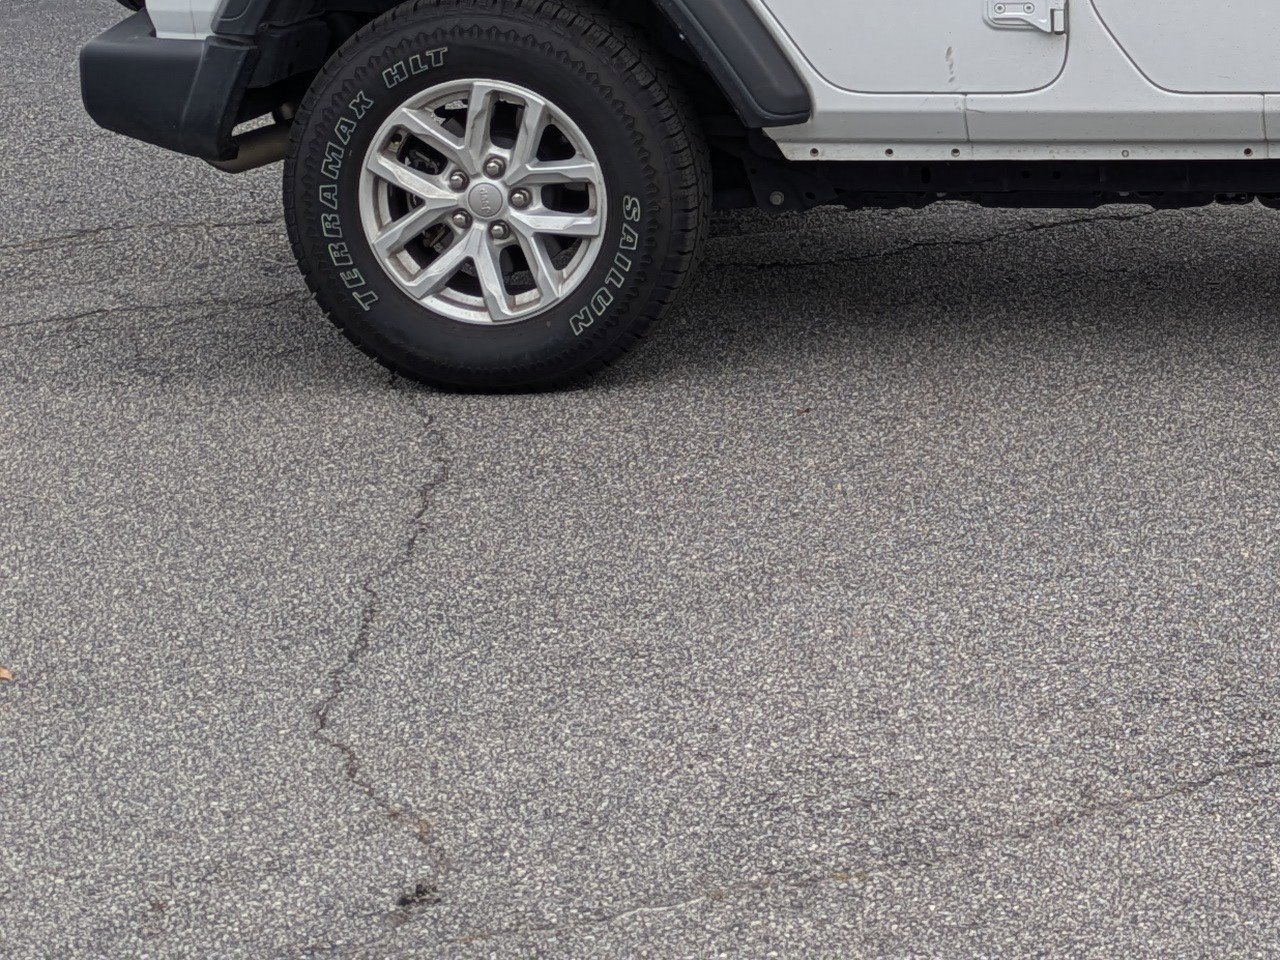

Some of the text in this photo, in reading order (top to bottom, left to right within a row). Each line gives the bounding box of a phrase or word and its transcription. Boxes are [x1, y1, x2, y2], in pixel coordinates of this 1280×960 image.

[319, 47, 448, 312] TERRAMAX HLT
[569, 195, 641, 336] SAILUN
